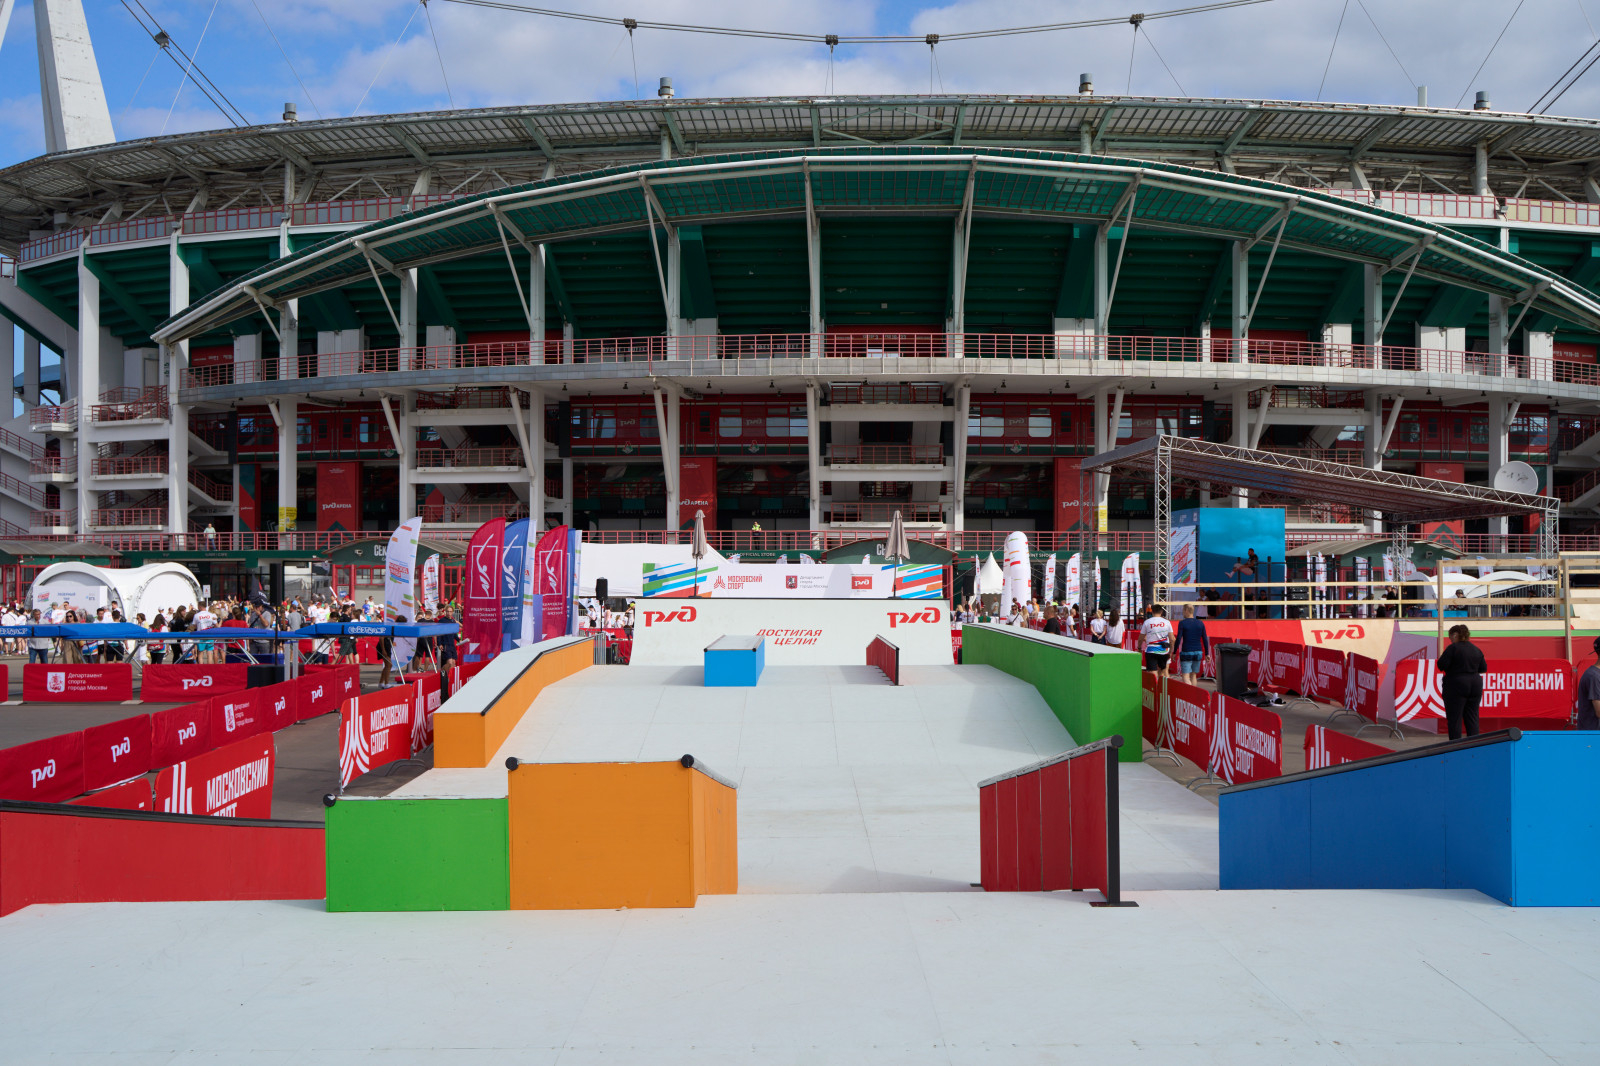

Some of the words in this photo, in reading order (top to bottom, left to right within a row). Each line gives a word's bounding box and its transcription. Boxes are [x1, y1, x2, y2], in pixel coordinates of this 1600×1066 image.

[728, 573, 763, 583] МОСКОВСКИЙ
[728, 582, 744, 590] СПОРТ
[774, 637, 818, 646] ЦЕЛИ!
[67, 672, 103, 681] Департамент
[67, 684, 86, 692] города
[371, 699, 409, 733] МОСКОВСКИЙ
[371, 729, 390, 756] СПОРТ
[1236, 721, 1277, 764] МОСКОВСКИЙ
[1236, 747, 1254, 778] СПОРТ
[207, 749, 269, 813] МОСКОВСКИЙ
